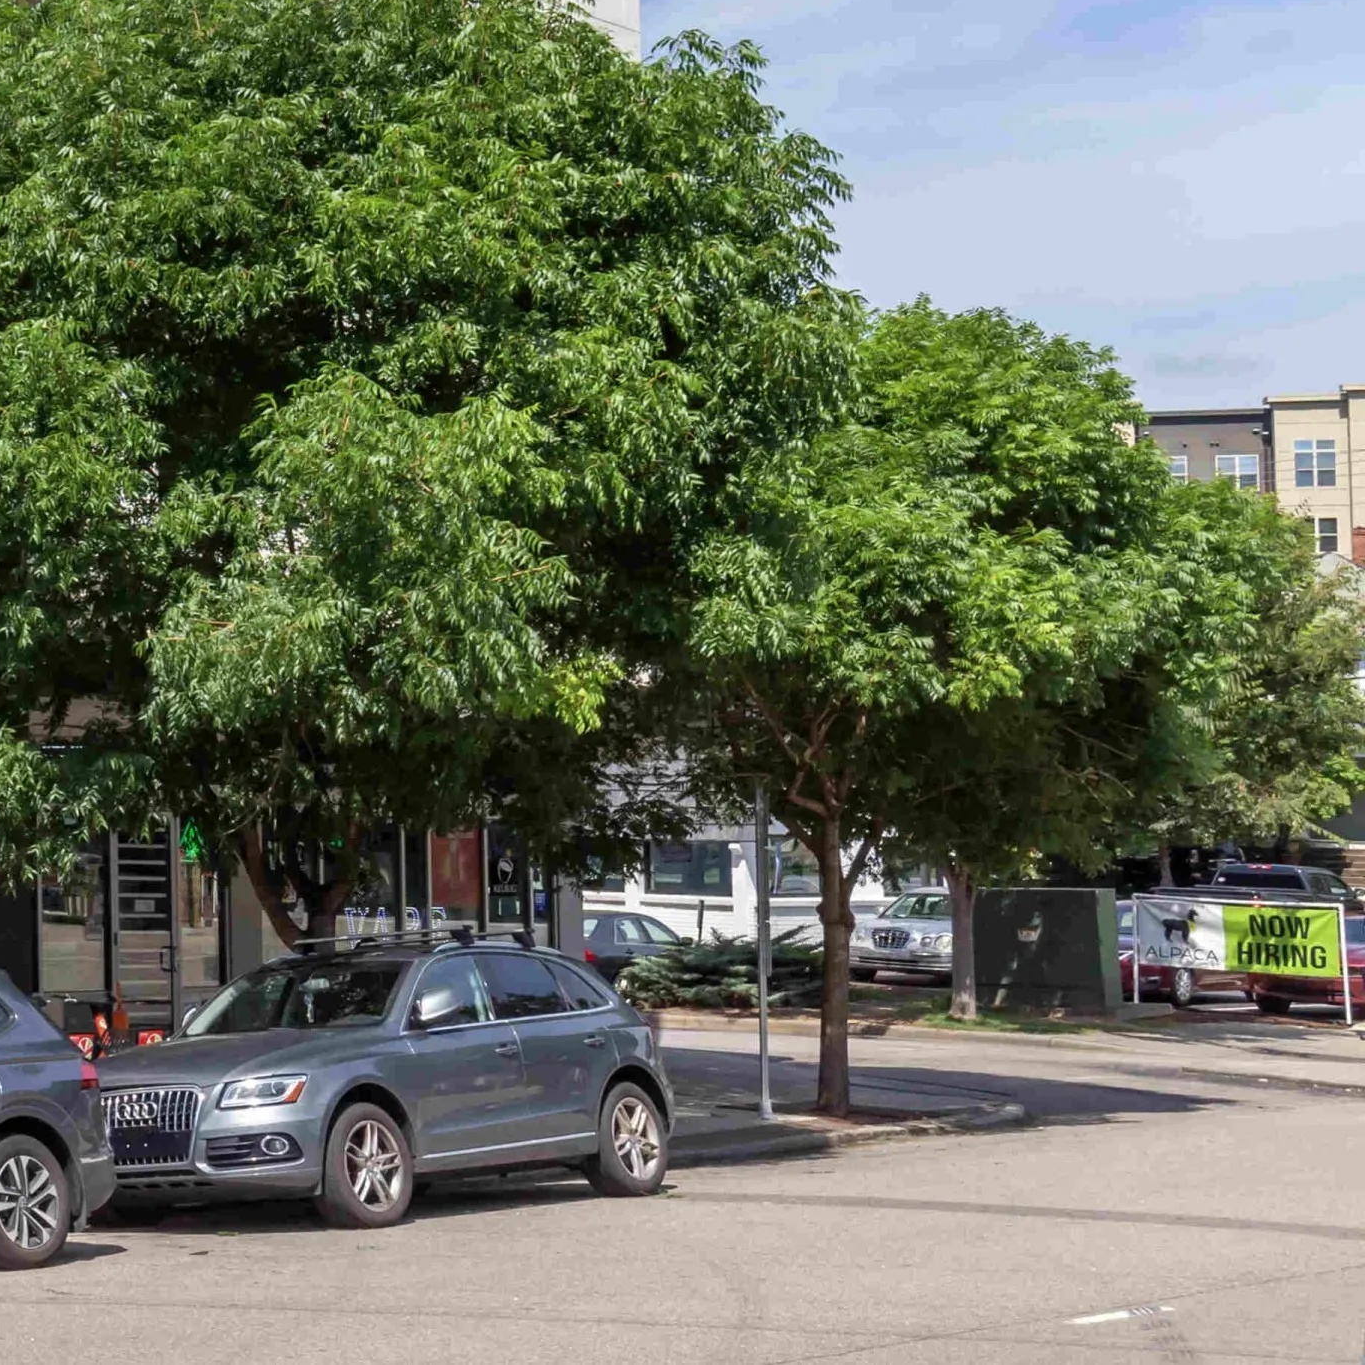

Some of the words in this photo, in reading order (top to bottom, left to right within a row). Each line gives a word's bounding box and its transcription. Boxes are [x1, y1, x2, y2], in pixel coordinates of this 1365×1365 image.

[1248, 914, 1310, 939] NOW
[1145, 946, 1220, 962] ALPACA
[1236, 941, 1327, 969] HIRING
